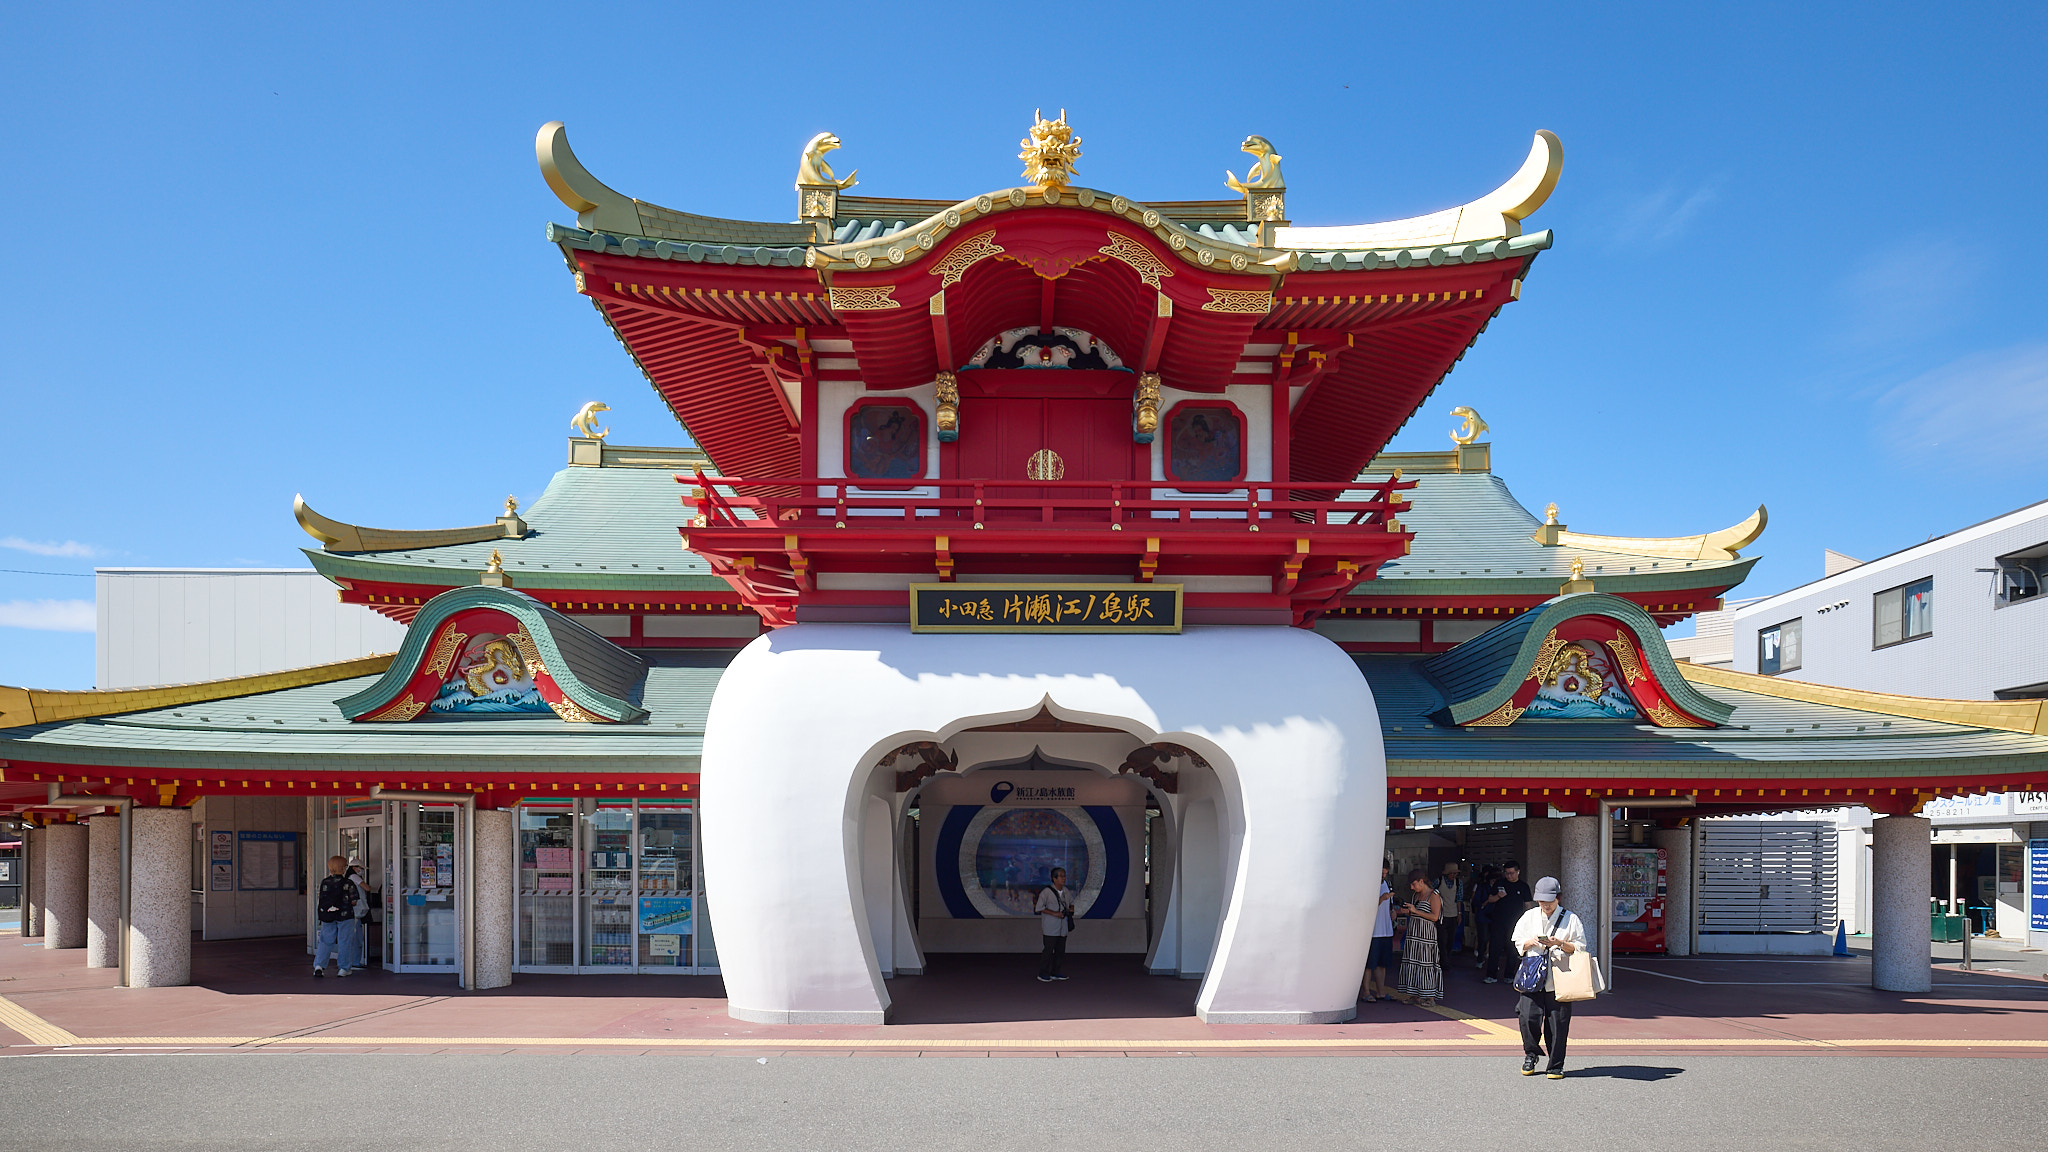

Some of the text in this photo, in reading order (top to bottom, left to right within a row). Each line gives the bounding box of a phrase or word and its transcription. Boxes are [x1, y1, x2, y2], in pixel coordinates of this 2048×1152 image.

[938, 592, 1154, 624] 小田急 片瀬江ノ島駅
[1016, 787, 1075, 797] 新江ノ島水族館
